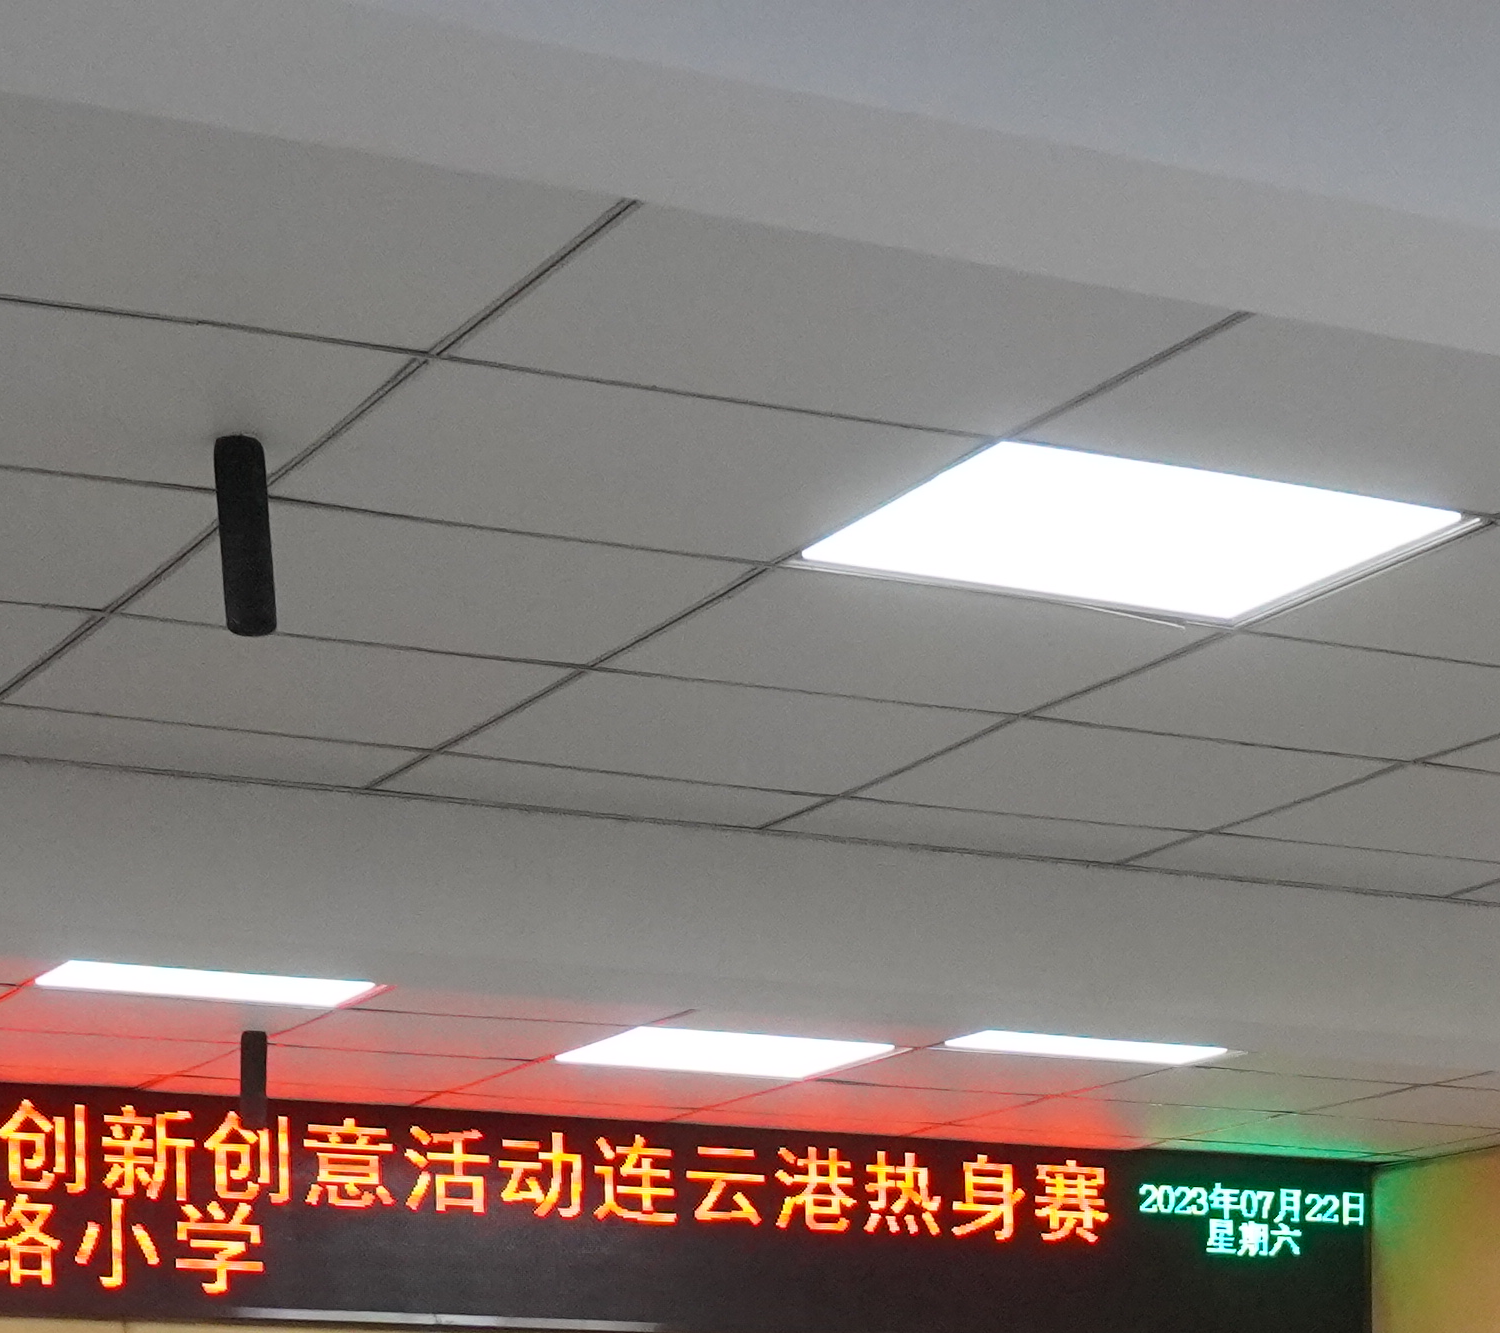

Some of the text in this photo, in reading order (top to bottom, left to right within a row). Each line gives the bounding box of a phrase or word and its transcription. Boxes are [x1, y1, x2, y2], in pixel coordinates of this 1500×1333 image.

[1139, 1183, 1366, 1227] 2023年07月22日
[1206, 1220, 1303, 1258] 星期六
